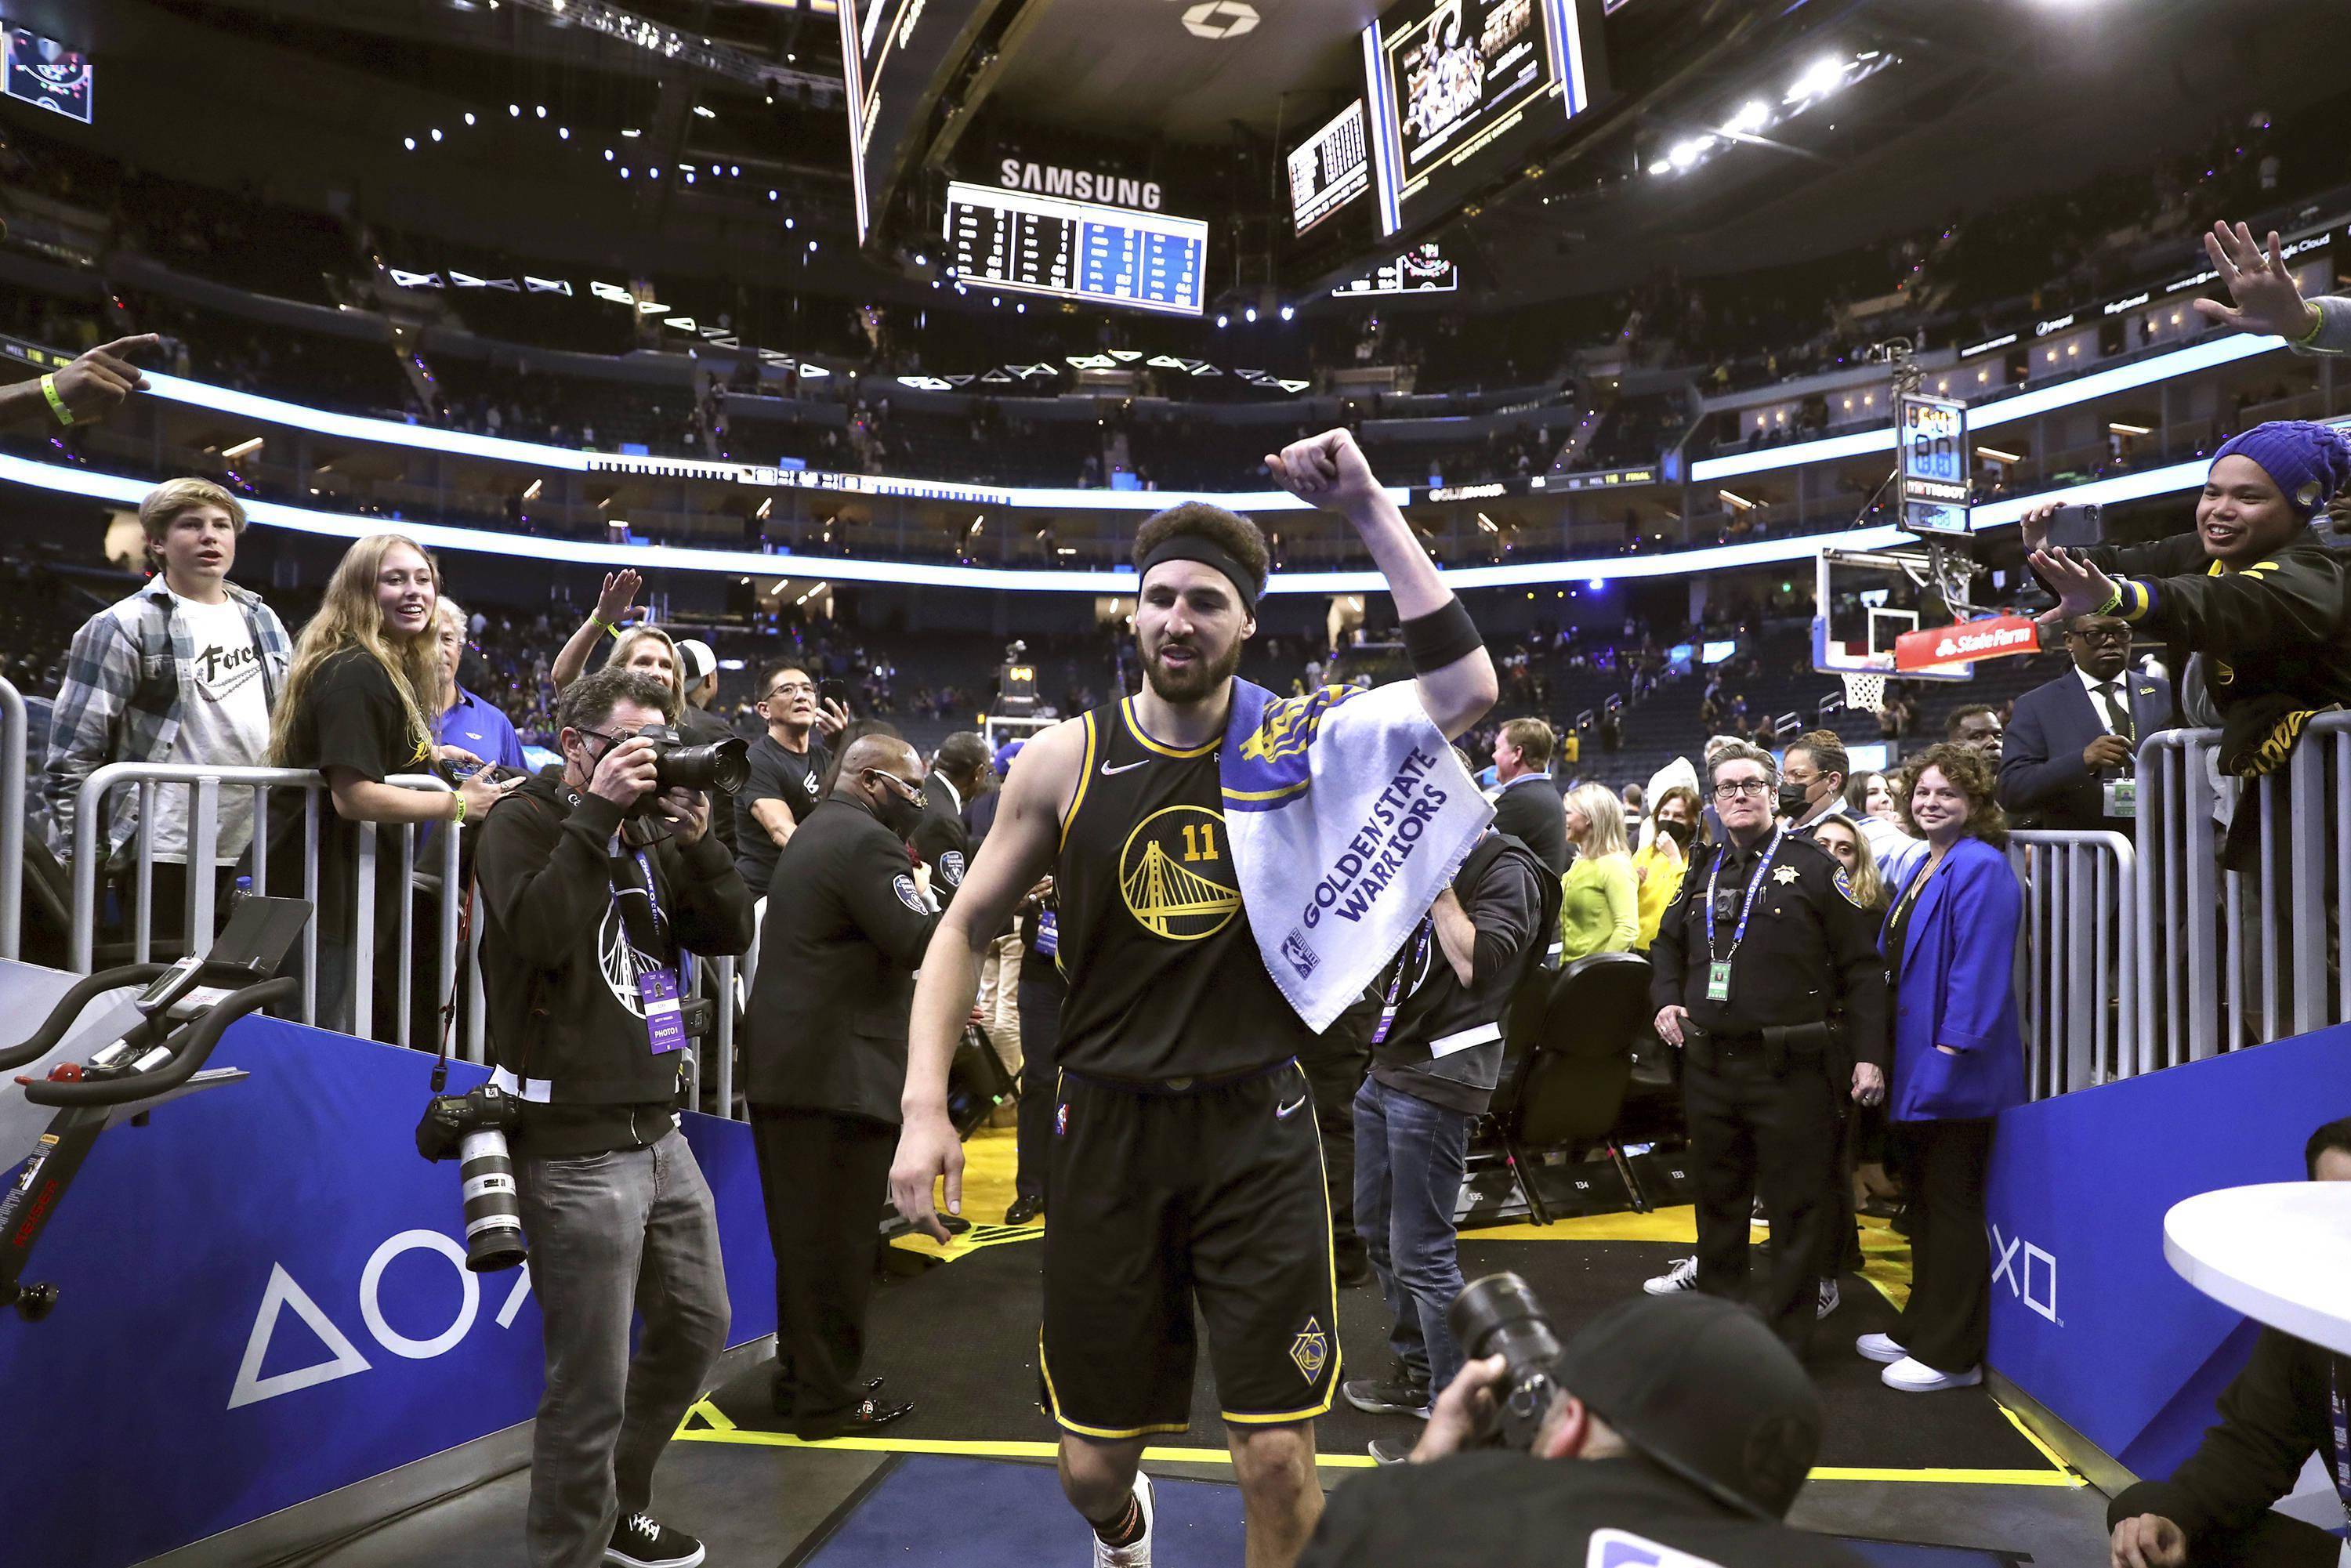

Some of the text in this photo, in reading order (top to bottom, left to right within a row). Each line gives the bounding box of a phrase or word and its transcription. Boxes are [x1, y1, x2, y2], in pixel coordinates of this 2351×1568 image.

[1001, 158, 1161, 209] SAMSUNG
[2298, 233, 2330, 252] Cloud
[1925, 484, 1967, 500] TISSOT
[1957, 628, 2031, 653] State Farm
[1183, 823, 1219, 862] 11
[1303, 746, 1439, 929] GOLDEN STATE
[1334, 783, 1448, 923] WARRIORS
[639, 859, 660, 936] CHASE CENTER
[1706, 871, 1718, 907] WARRIORS
[1741, 867, 1766, 918] CHASE CENTER
[654, 1027, 675, 1039] PHOTO
[1468, 1192, 1483, 1201] 135
[1574, 1180, 1590, 1190] 134
